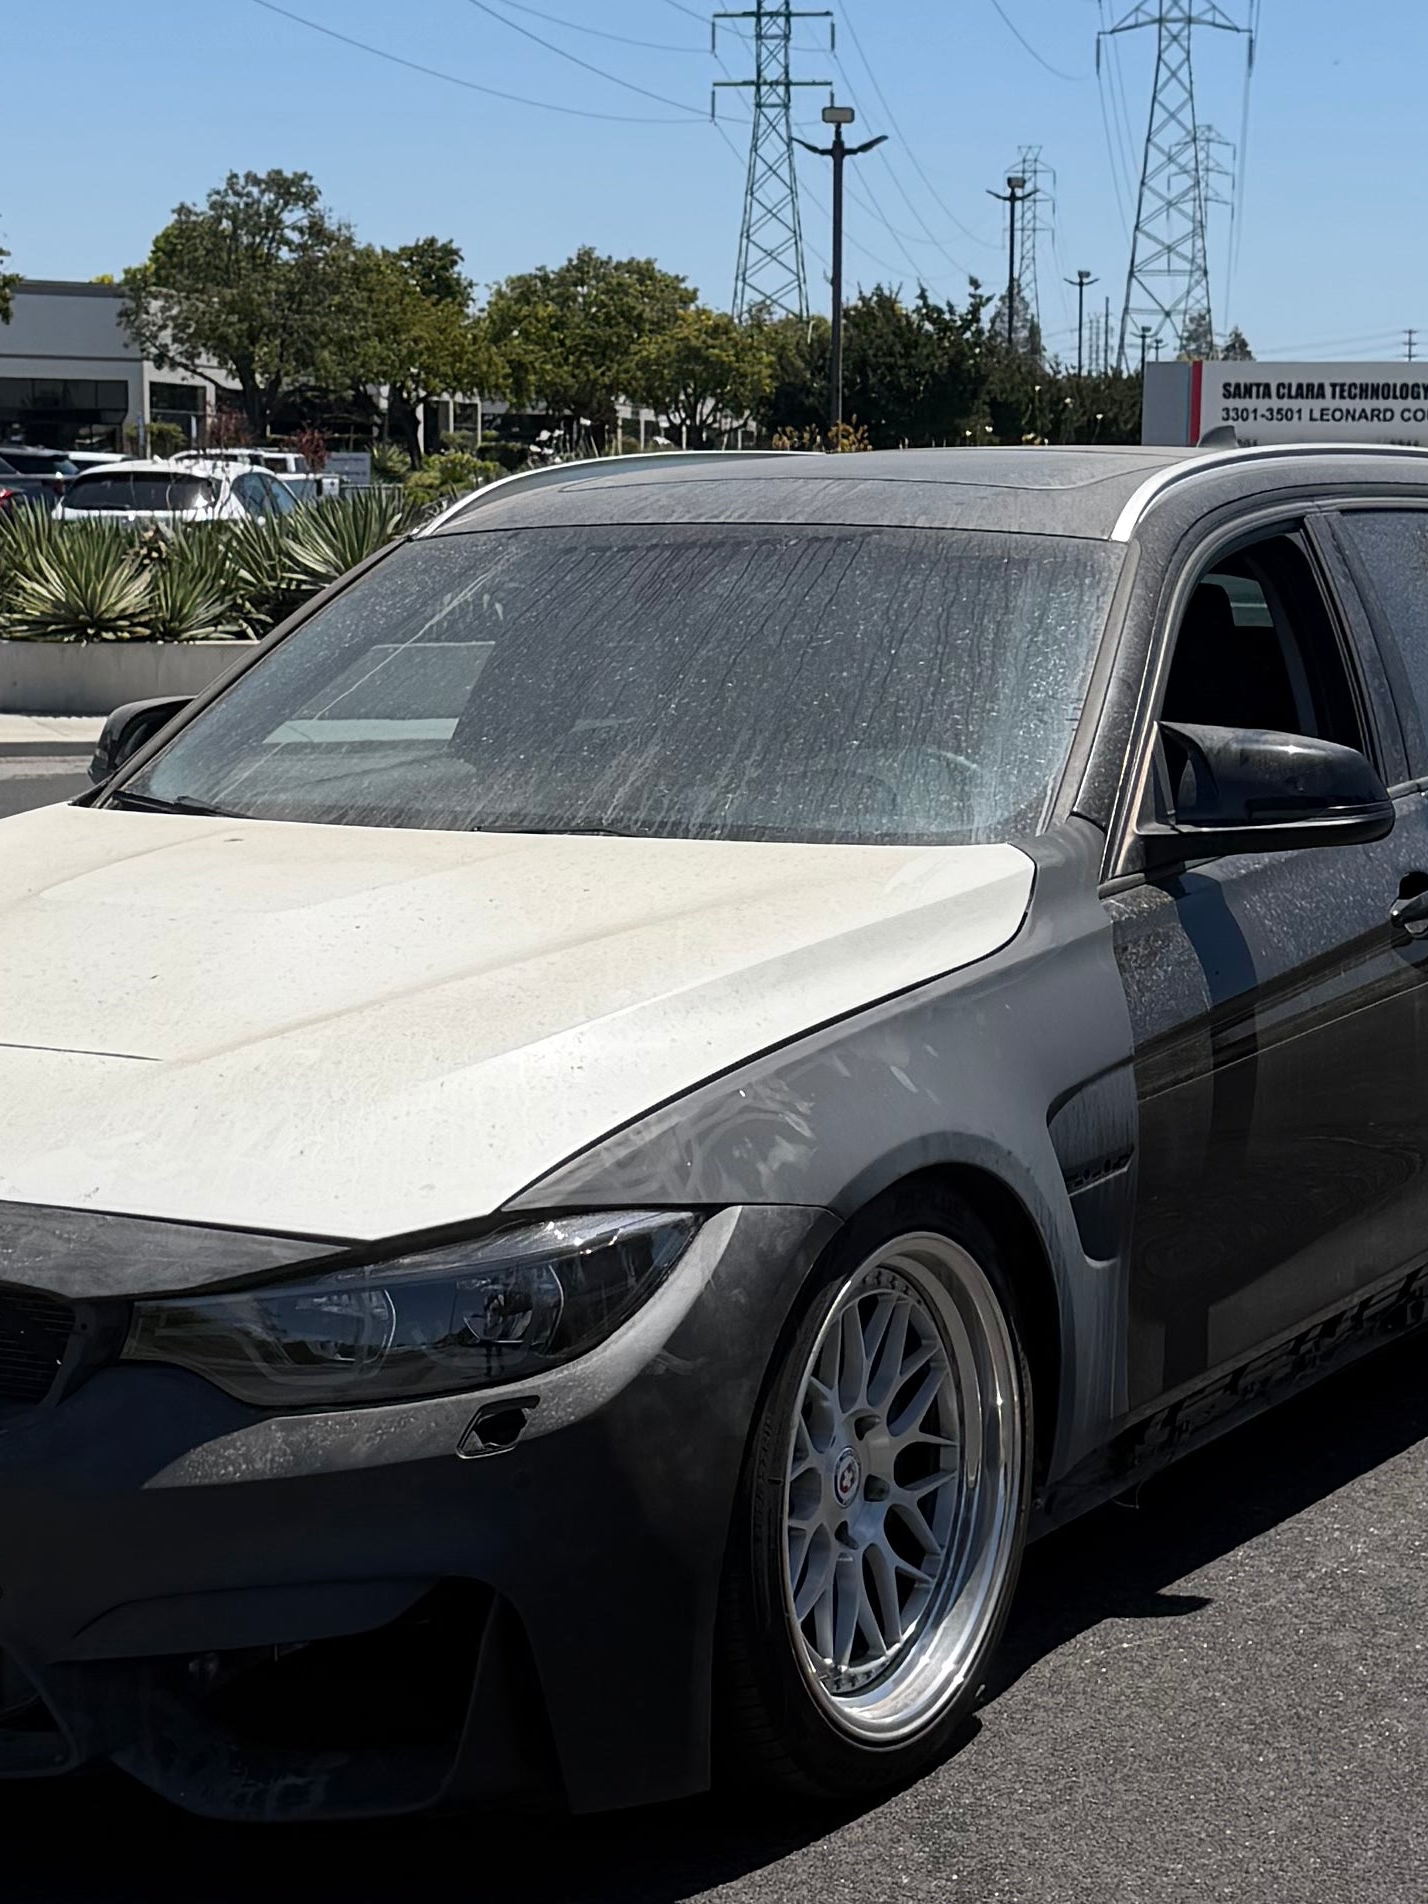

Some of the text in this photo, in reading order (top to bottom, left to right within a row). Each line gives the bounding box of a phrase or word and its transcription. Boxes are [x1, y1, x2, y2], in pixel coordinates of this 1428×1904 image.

[1222, 382, 1272, 400] SANTA
[1275, 382, 1326, 400] CLARA
[1221, 407, 1303, 422] 3301-3501
[1309, 408, 1395, 423] LEONARD
